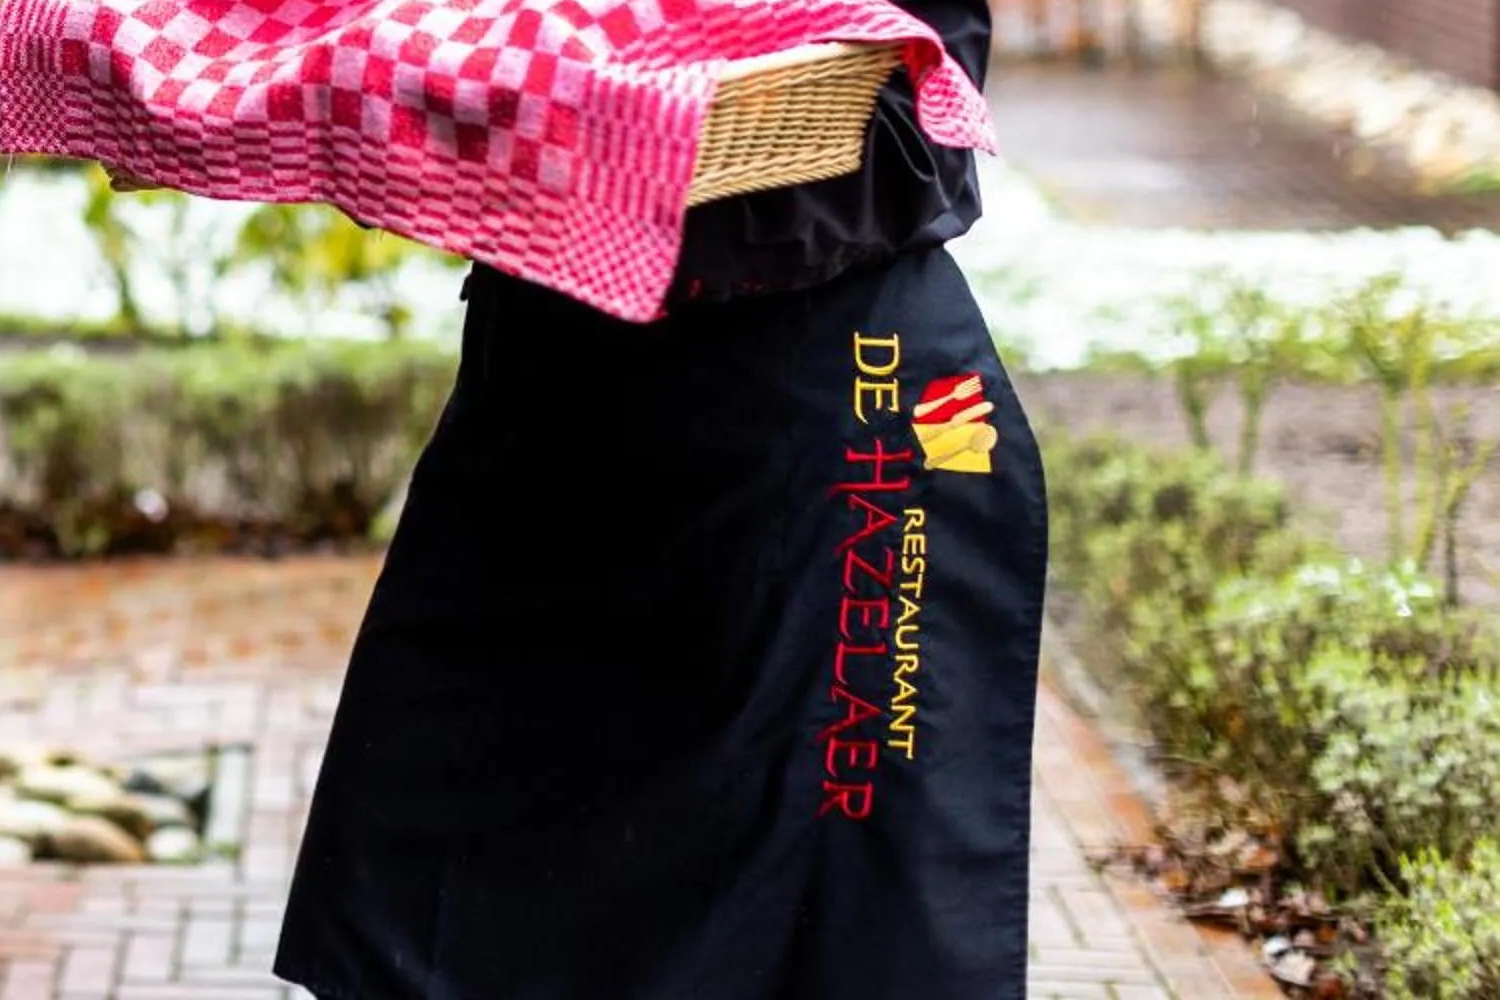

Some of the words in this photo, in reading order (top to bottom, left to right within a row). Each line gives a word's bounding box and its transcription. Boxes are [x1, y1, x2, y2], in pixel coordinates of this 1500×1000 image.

[853, 332, 900, 425] DE
[817, 438, 913, 820] HAZELAER
[887, 507, 926, 760] RESTAURANT
